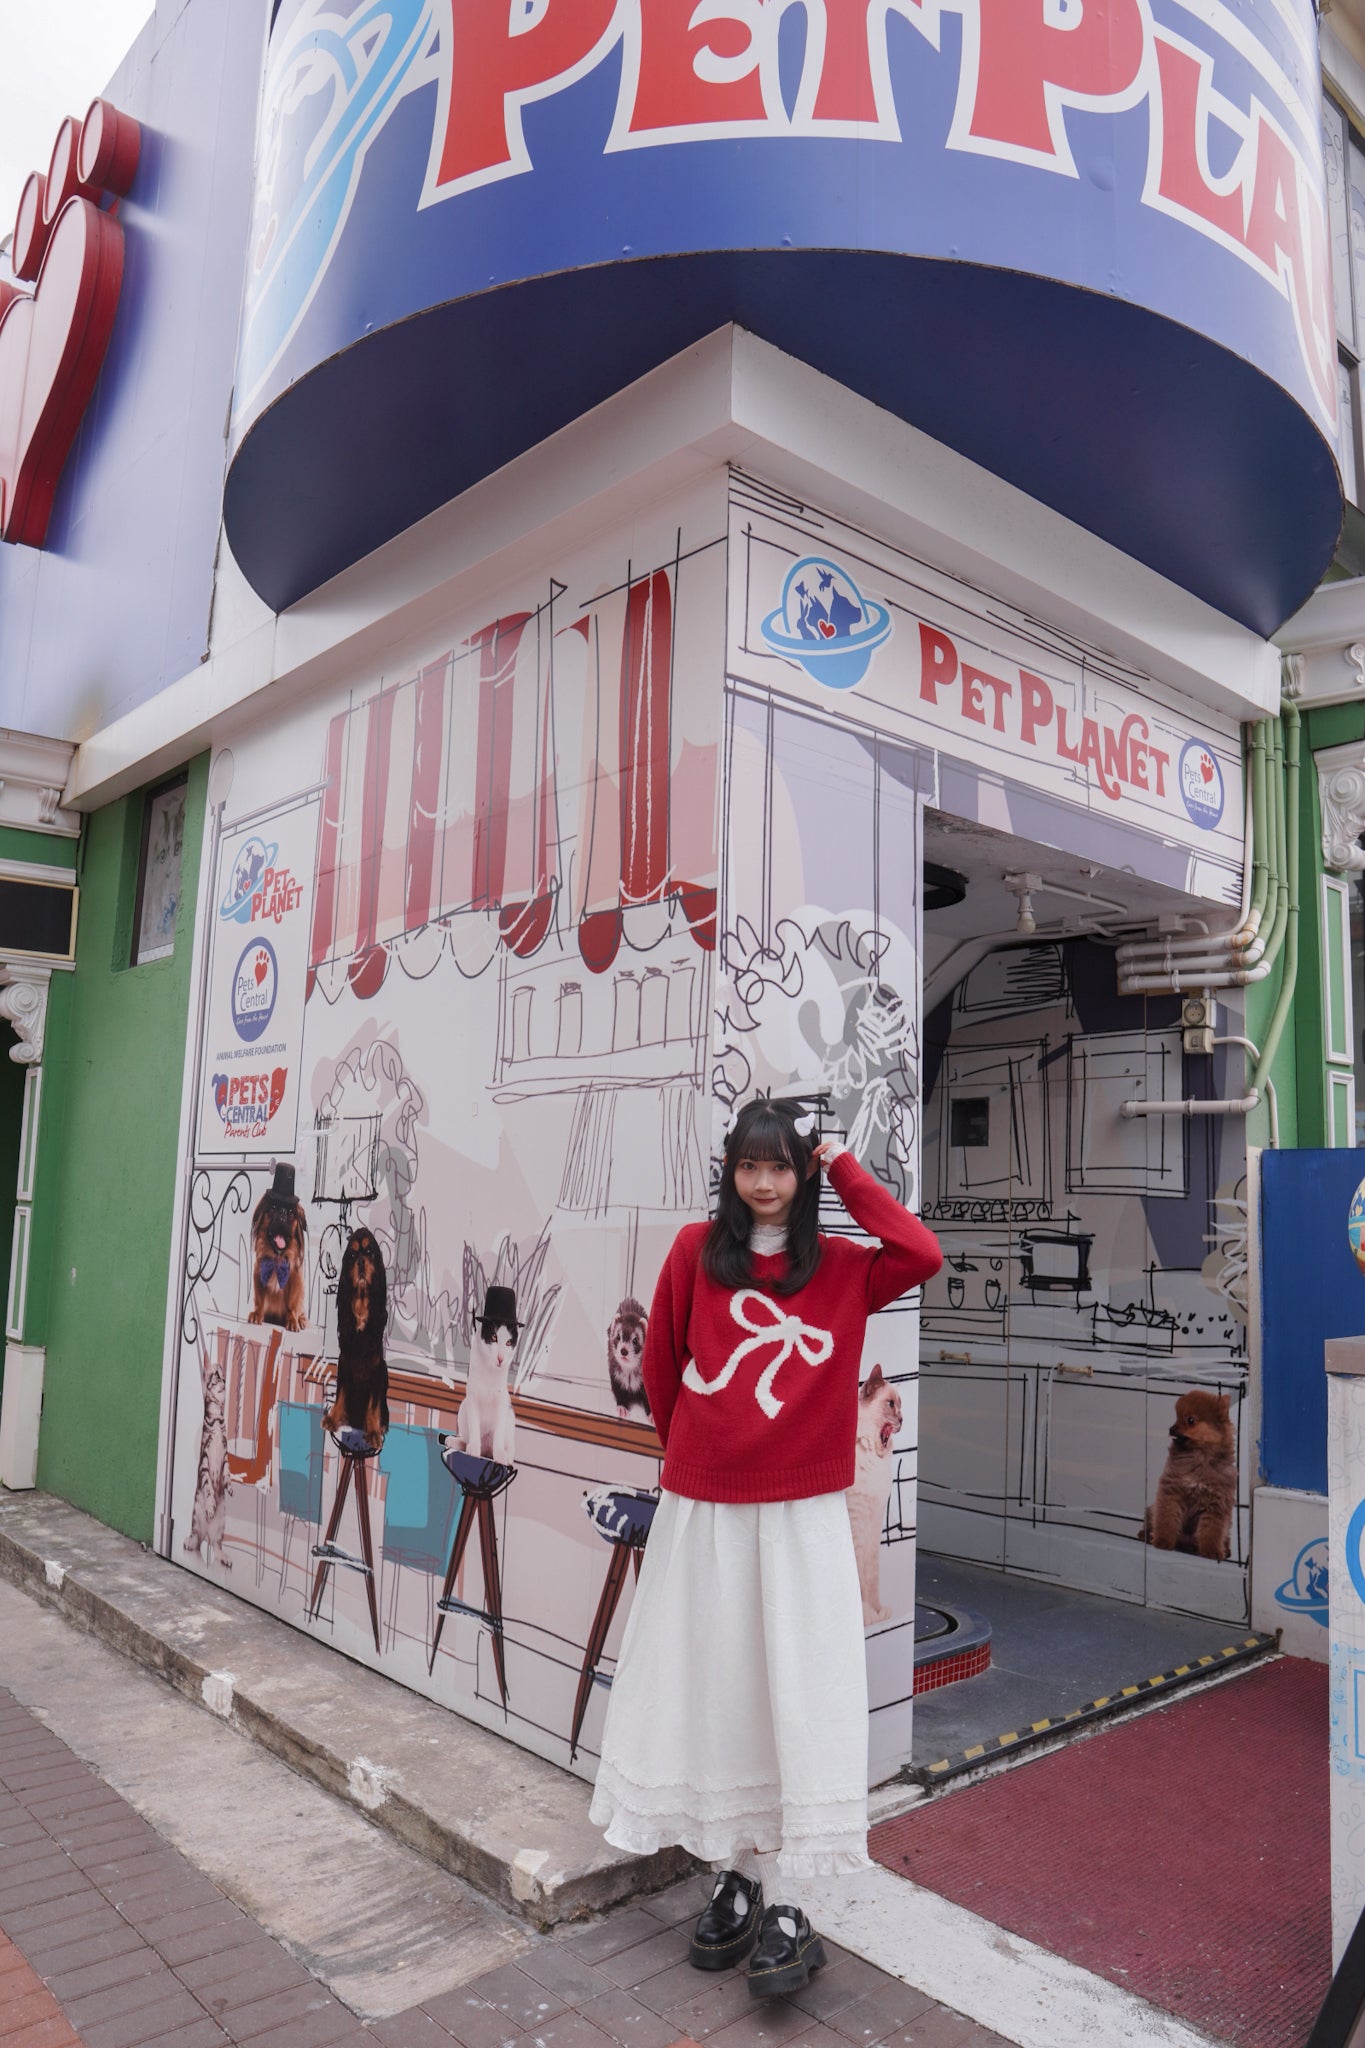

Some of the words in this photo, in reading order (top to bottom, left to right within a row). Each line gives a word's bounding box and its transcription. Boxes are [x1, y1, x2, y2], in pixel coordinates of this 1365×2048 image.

[918, 622, 1012, 733] PET
[1018, 668, 1170, 801] PLANET
[1184, 763, 1201, 783] Pets
[1188, 781, 1217, 805] Central
[263, 867, 290, 897] PET
[251, 877, 304, 924] PLANET
[237, 976, 255, 996] Pets
[240, 988, 268, 1012] Central
[216, 1051, 233, 1061] ANIMAL
[234, 1047, 254, 1058] WELFARE
[254, 1043, 287, 1056] FOUNDATION
[228, 1073, 269, 1106] PETS
[226, 1104, 269, 1124] CENTRAL
[224, 1121, 251, 1138] Parents
[251, 1120, 267, 1138] Club
